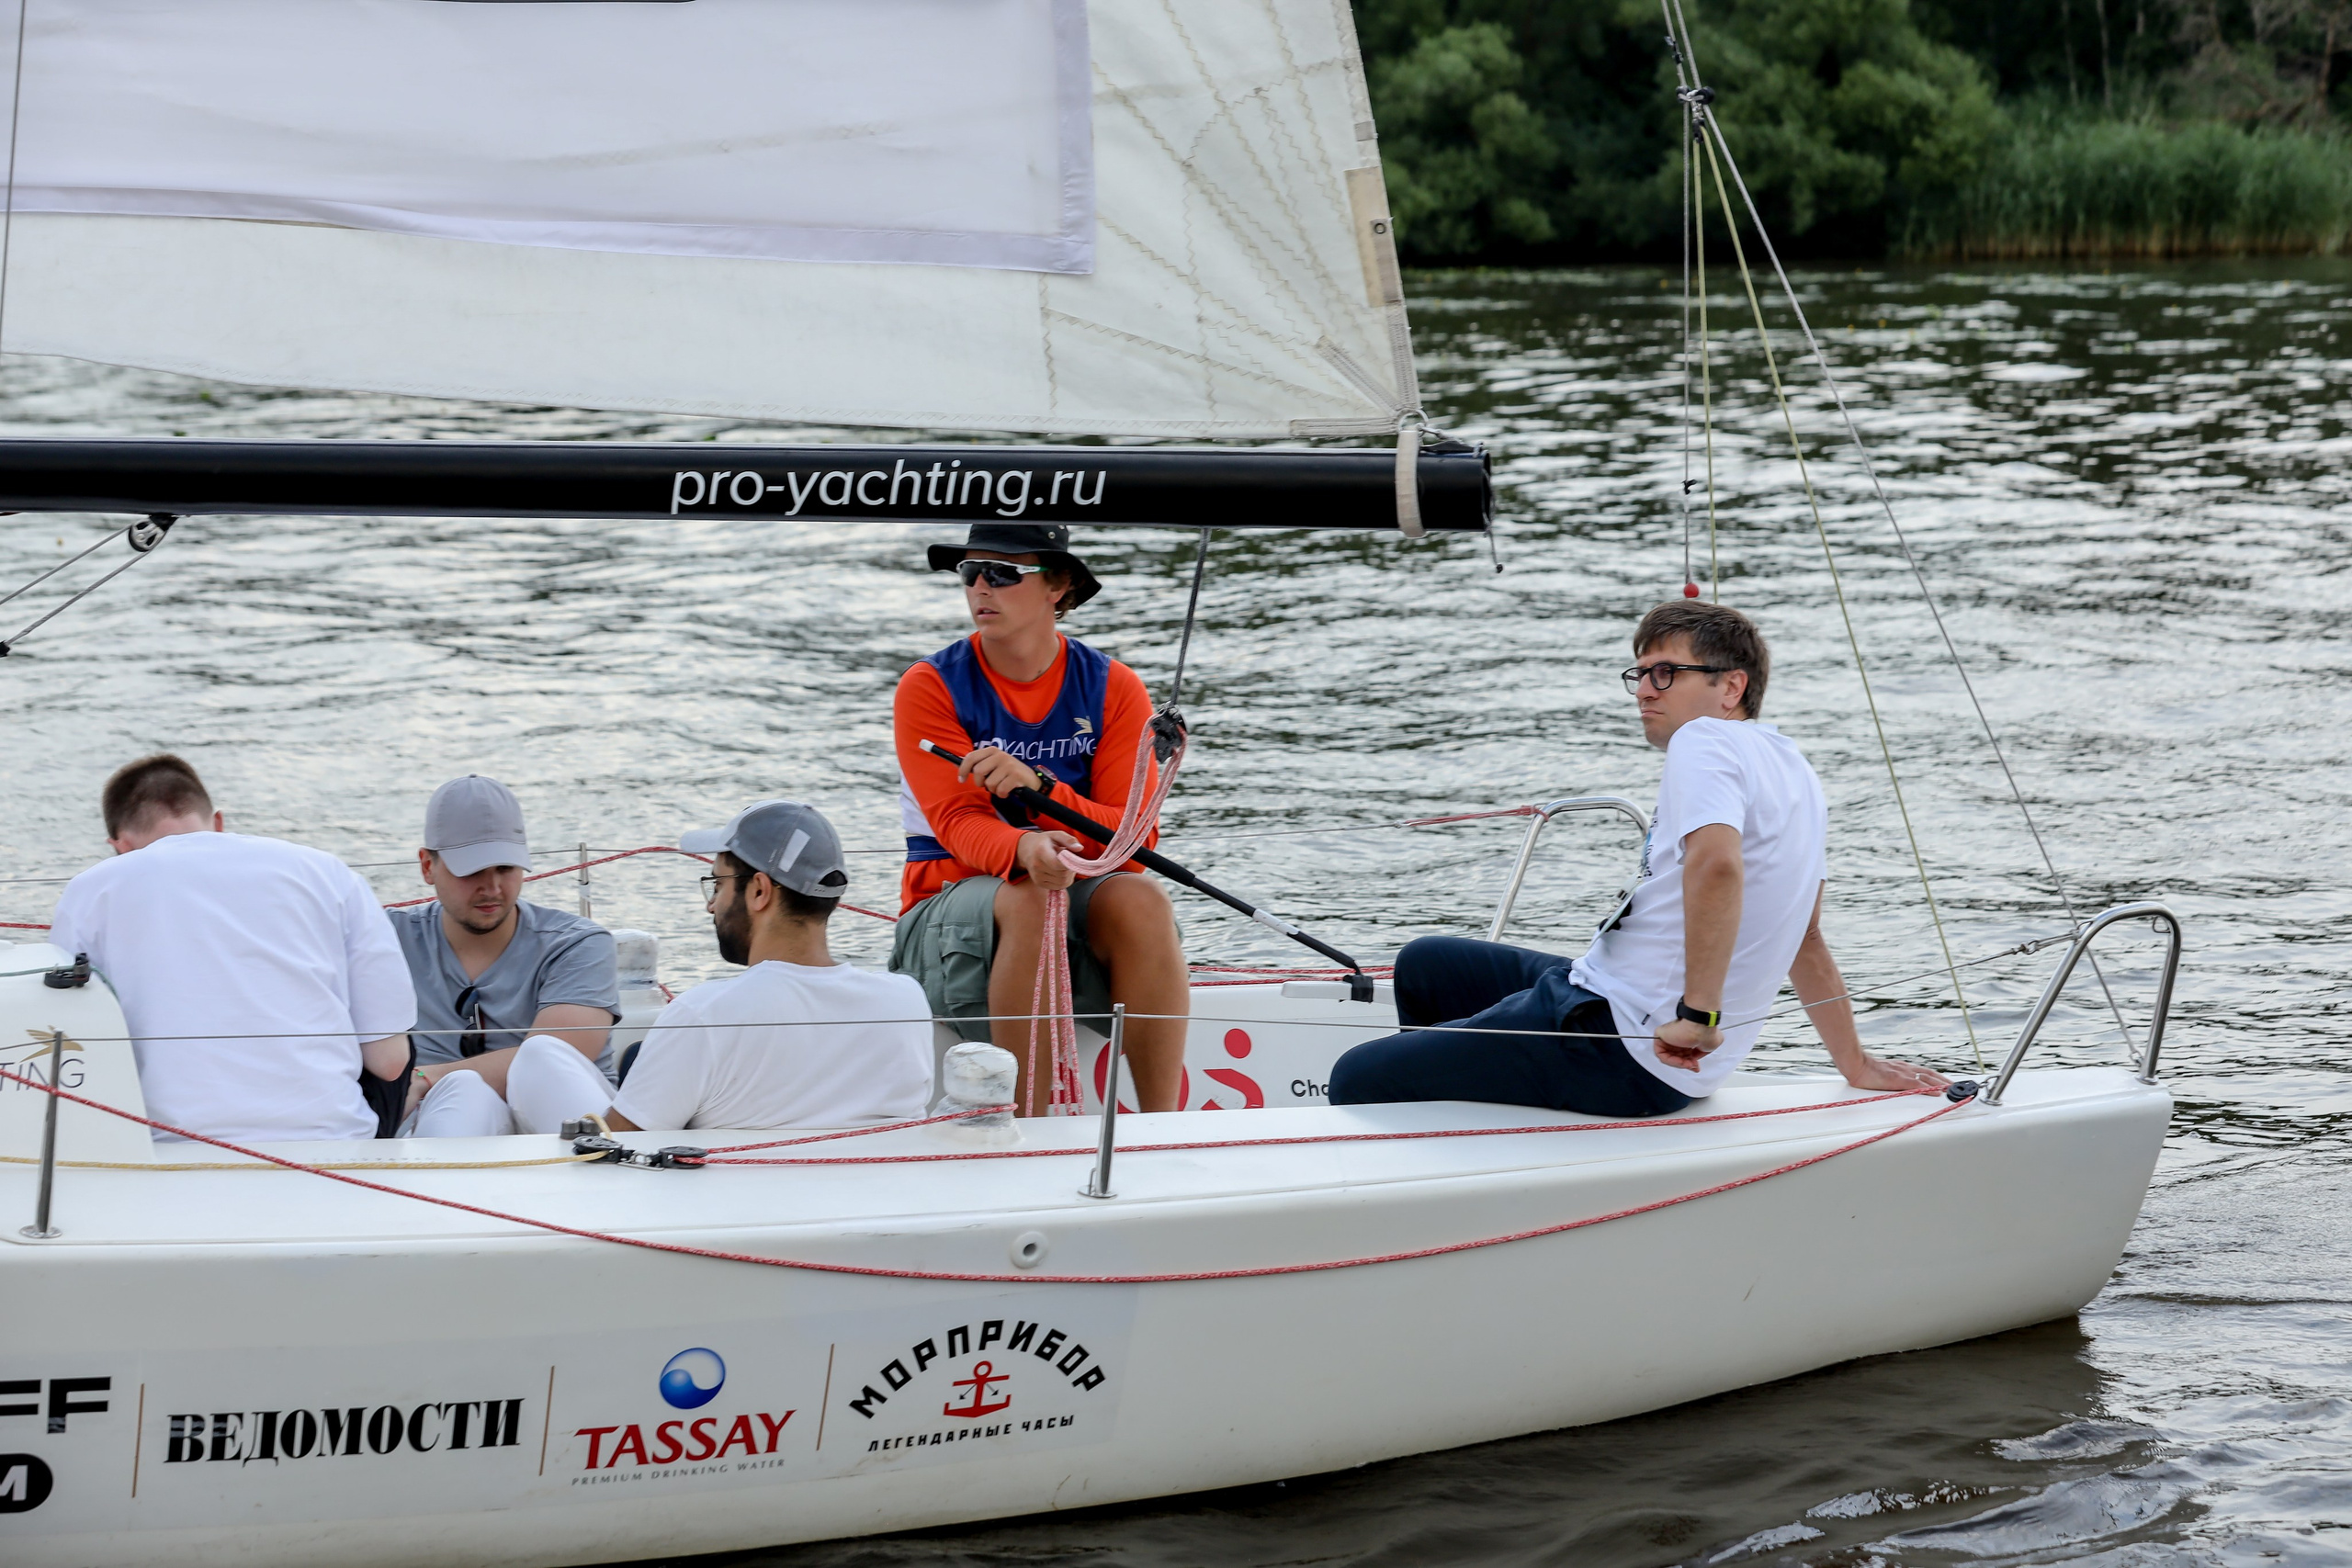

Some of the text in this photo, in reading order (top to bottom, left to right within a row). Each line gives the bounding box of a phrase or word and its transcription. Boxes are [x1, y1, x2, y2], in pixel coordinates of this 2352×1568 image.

[670, 458, 1107, 516] pro-yachting.ru
[849, 1319, 1106, 1419] МОРПРИБОР
[164, 1398, 525, 1468] ВЕДОМОСТИ
[575, 1410, 797, 1469] TASSAY
[867, 1415, 1075, 1452] ЛЕГЕНДАРНЫЕ ЧАСЫ
[571, 1459, 786, 1486] PREMIUM DRINKING WATER
